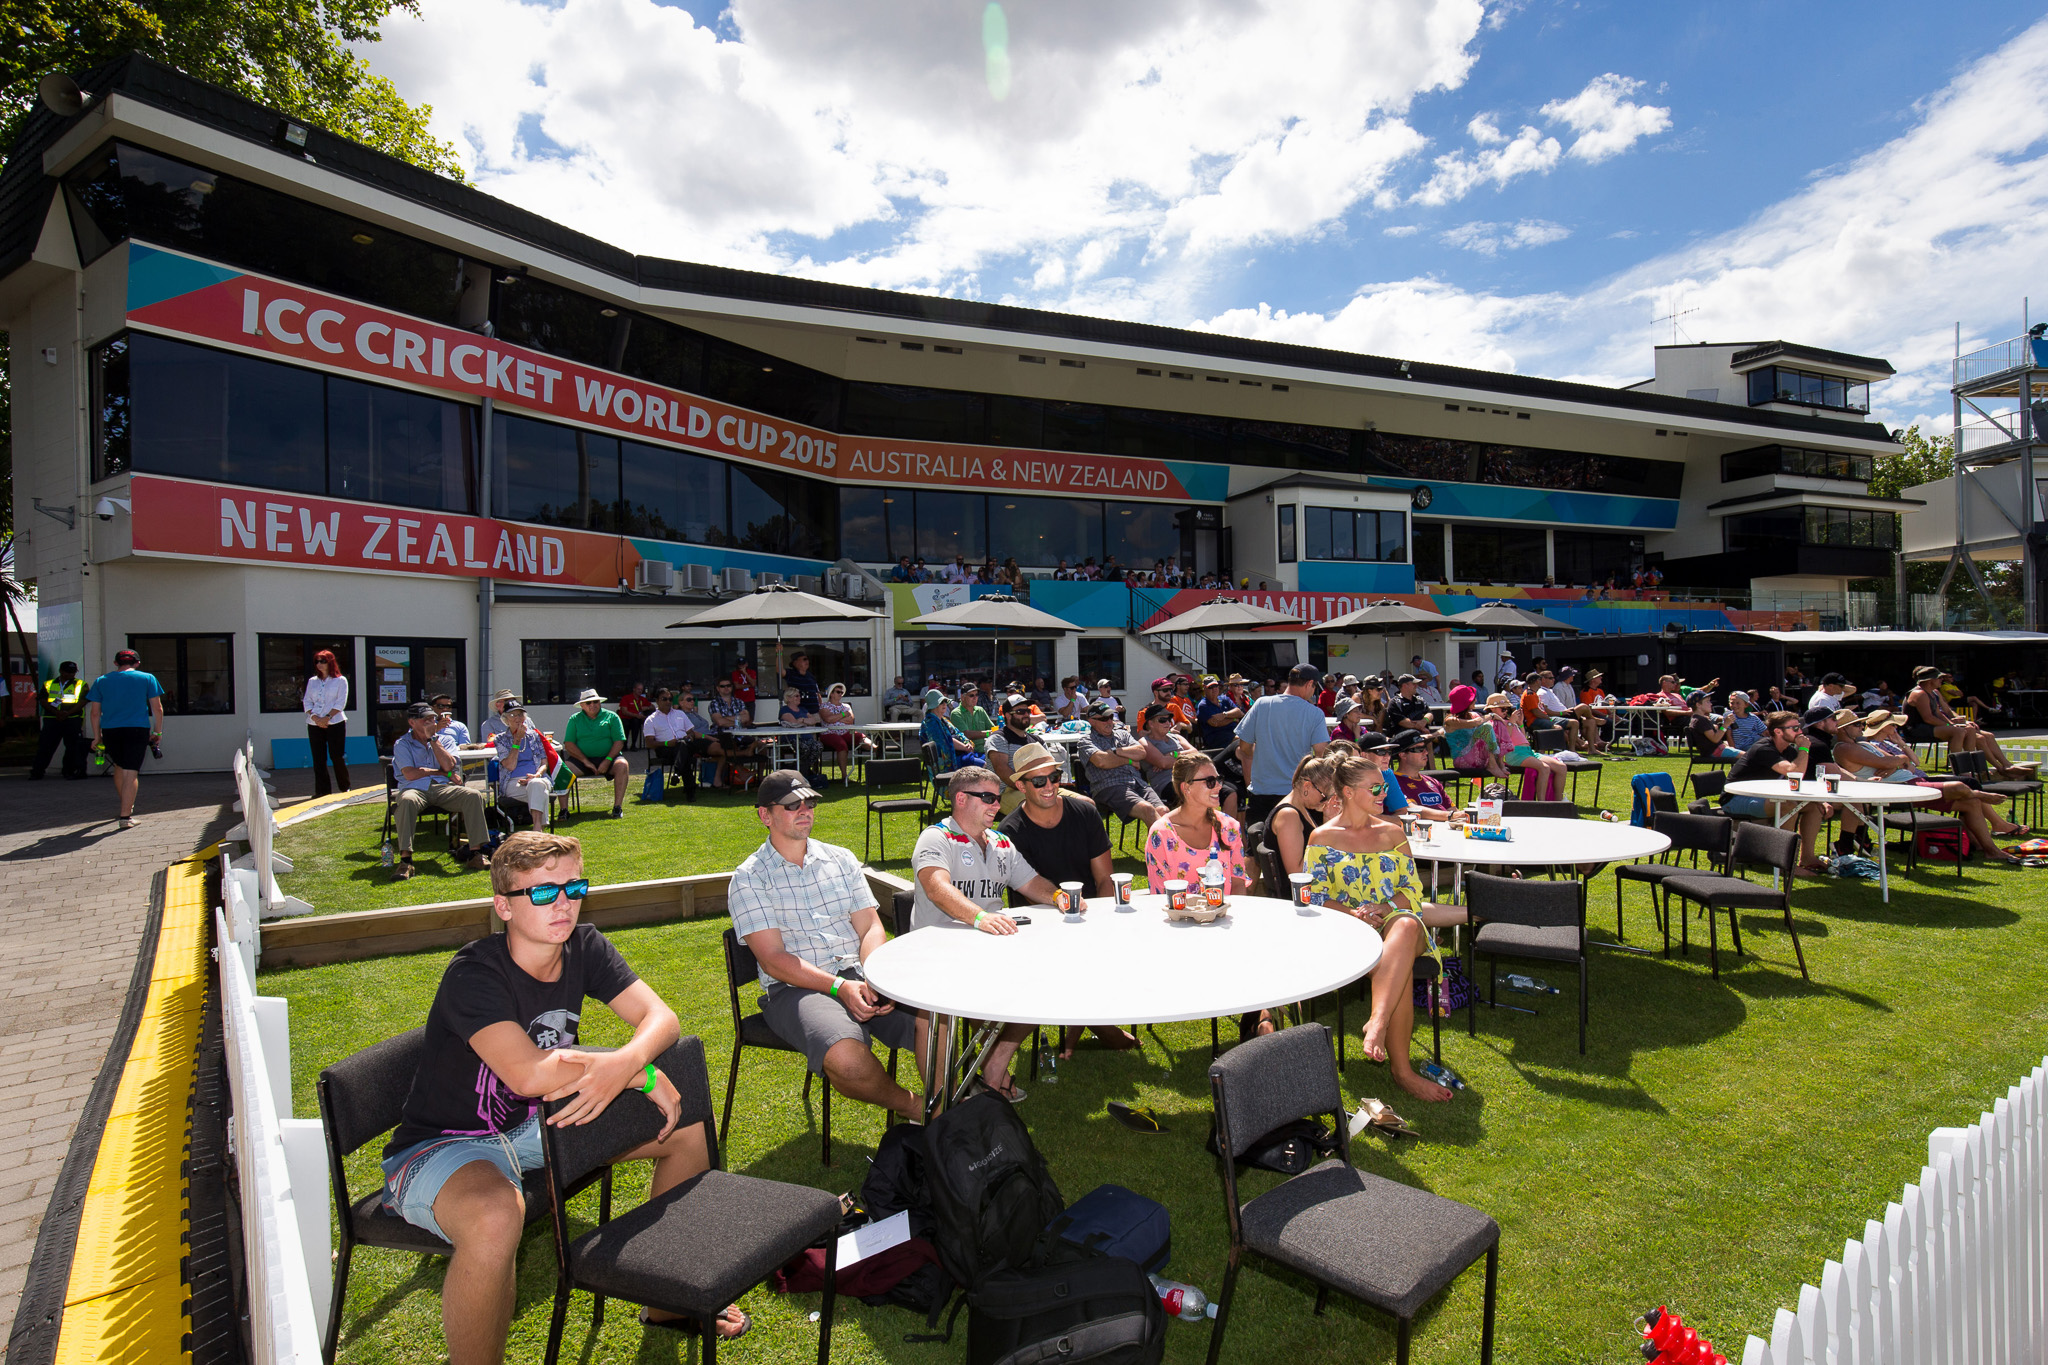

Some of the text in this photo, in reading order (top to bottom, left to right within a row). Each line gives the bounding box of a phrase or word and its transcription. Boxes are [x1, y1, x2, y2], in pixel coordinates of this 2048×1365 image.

[242, 288, 837, 468] ICC CRICKET WORLD CUP 2015
[849, 449, 1168, 491] AUSTRALIA & NEW ZEALAND
[220, 498, 565, 576] NEW ZEALAND
